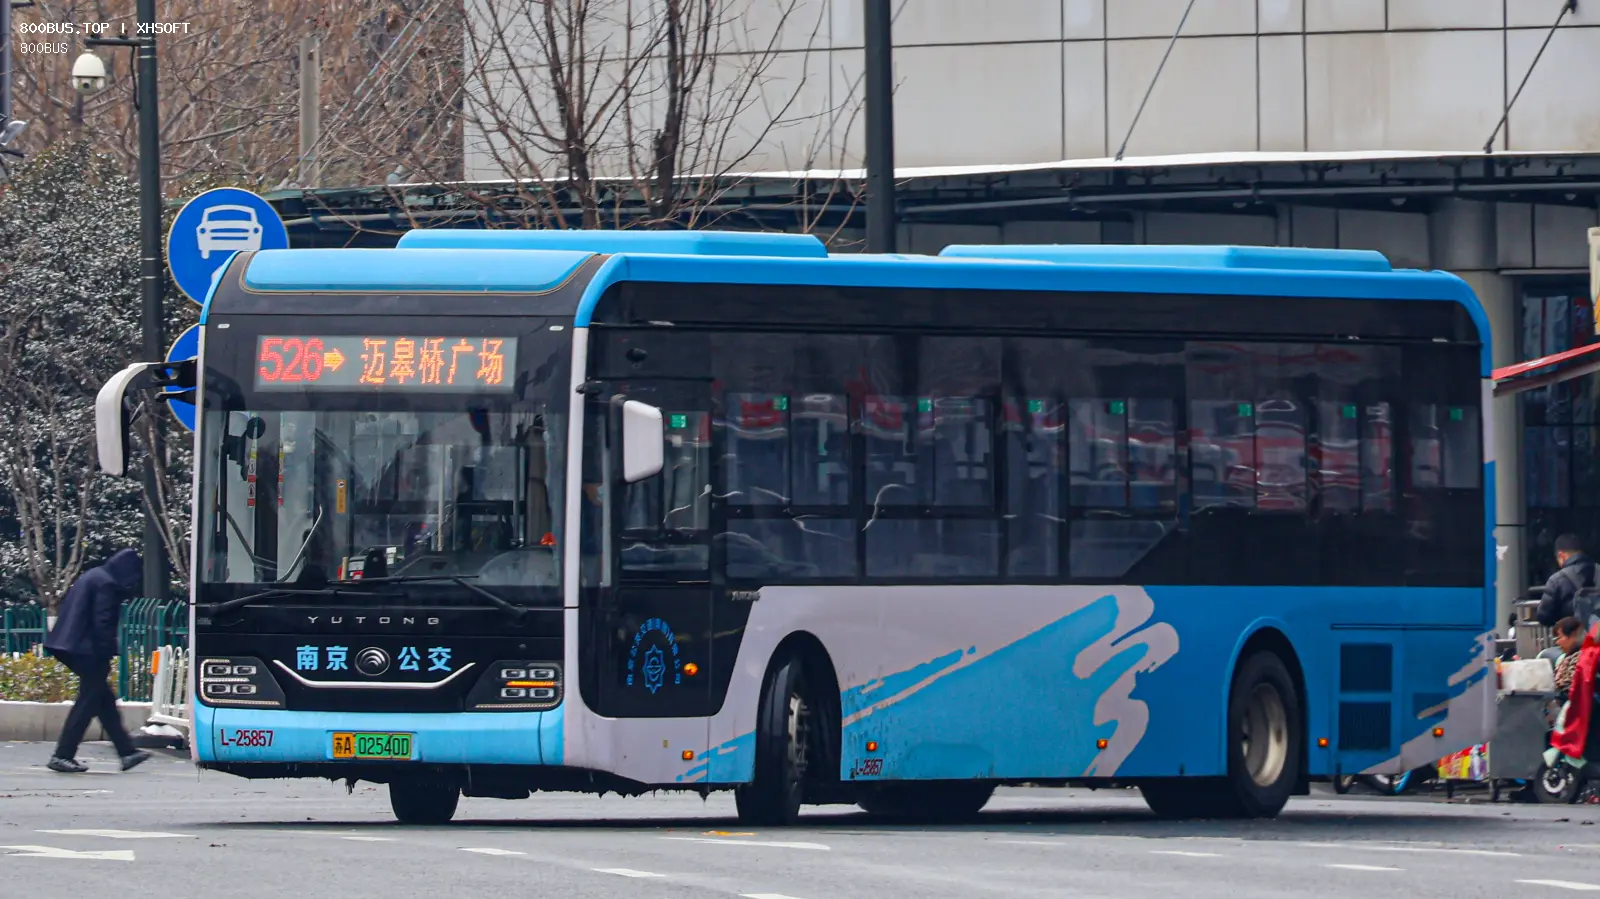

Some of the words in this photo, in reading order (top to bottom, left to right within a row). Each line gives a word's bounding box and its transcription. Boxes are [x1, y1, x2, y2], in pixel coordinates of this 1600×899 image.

[259, 337, 324, 381] 526
[359, 337, 505, 384] 迈皋桥广场
[307, 616, 440, 625] YUTONG
[296, 645, 349, 671] 南京
[398, 646, 452, 672] 公交
[220, 728, 274, 748] L-25857
